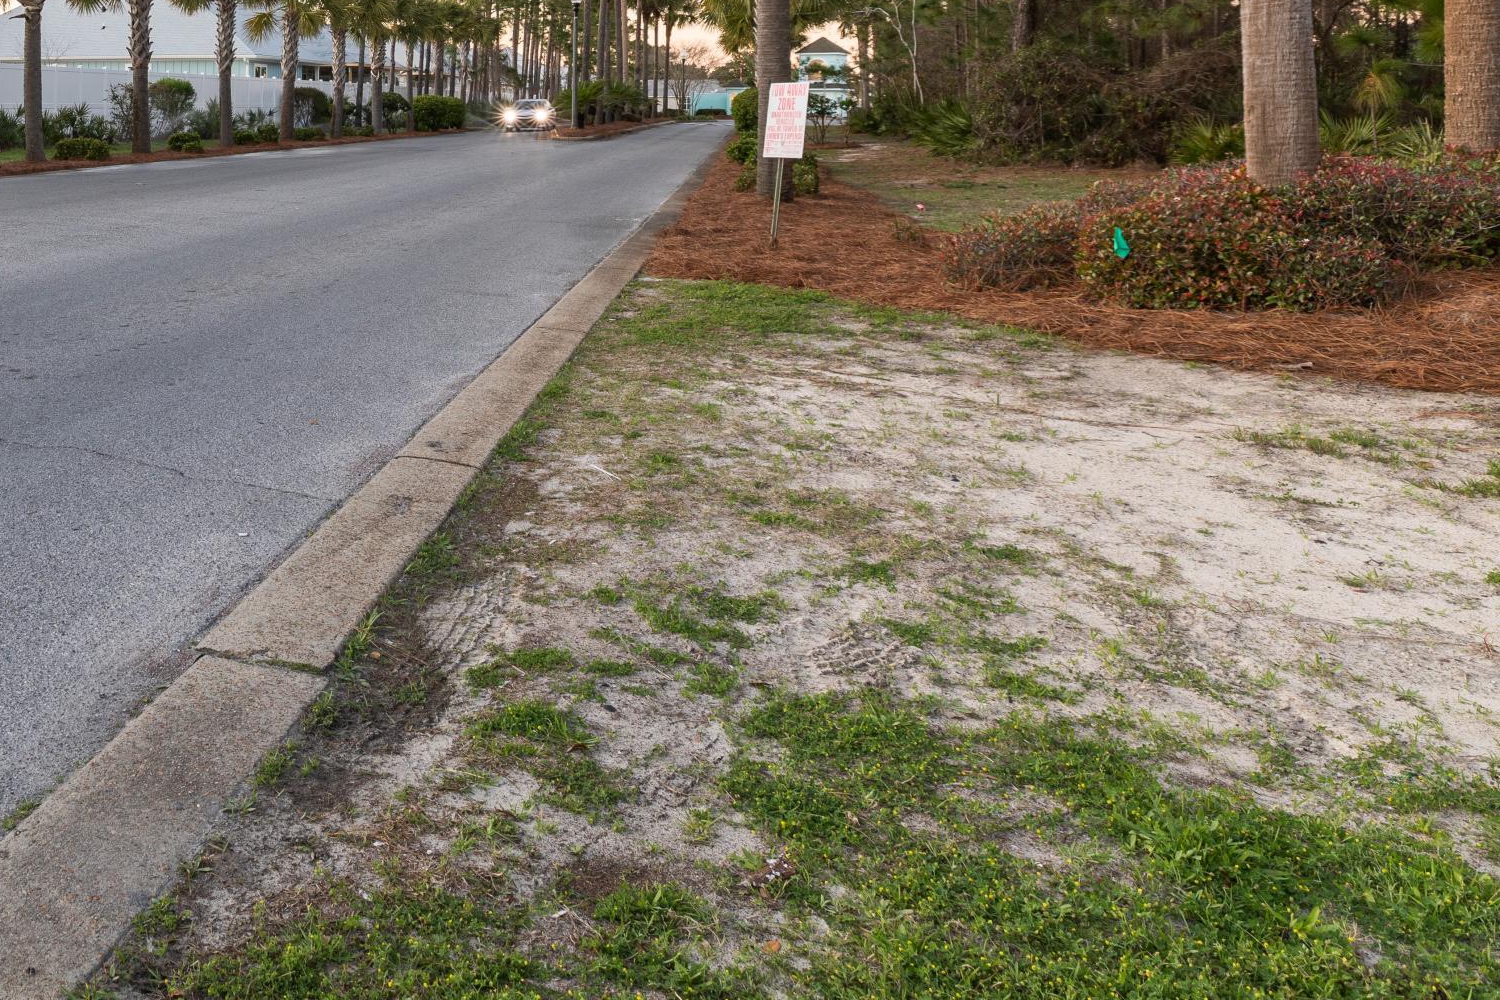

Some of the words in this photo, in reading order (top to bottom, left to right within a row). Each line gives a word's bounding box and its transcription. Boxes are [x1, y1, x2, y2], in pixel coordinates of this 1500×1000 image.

[771, 84, 785, 97] TOW
[787, 83, 807, 97] AWAY
[777, 97, 796, 110] ZONE
